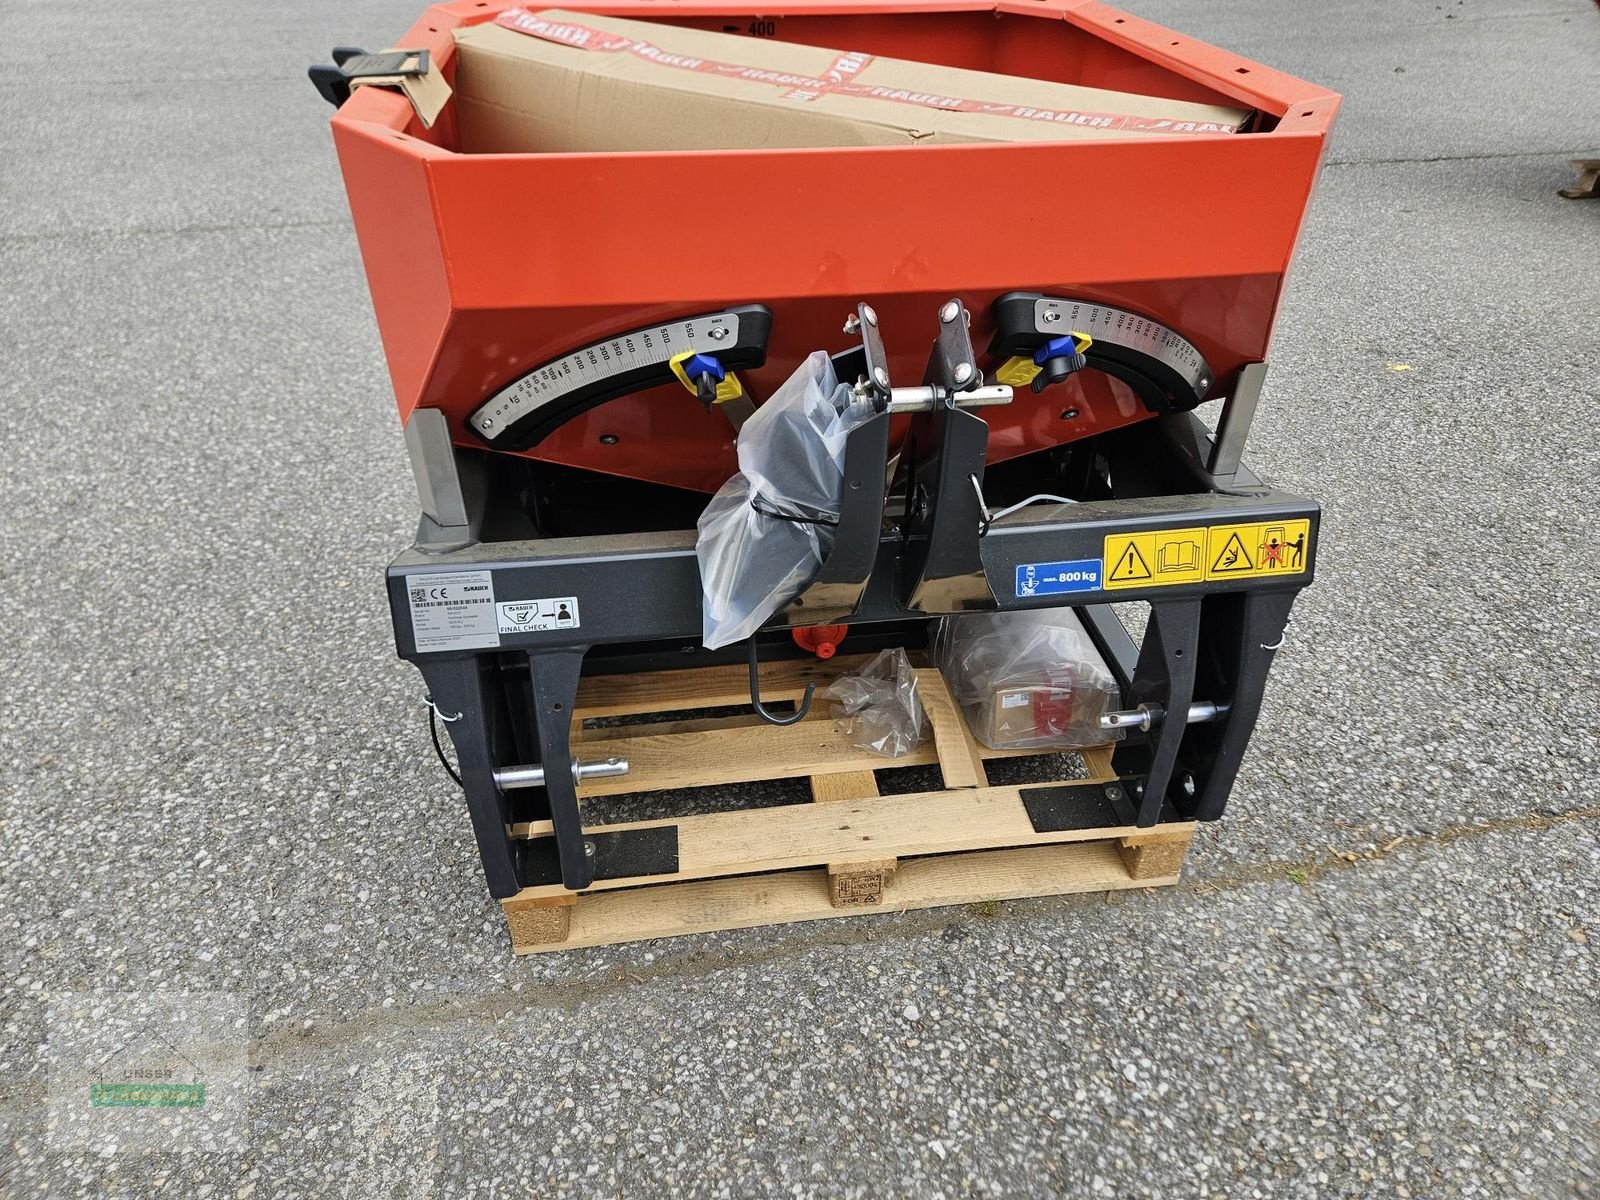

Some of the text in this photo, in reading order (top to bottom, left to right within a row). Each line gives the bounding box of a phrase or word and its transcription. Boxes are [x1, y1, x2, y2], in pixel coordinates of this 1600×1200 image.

[748, 21, 775, 36] 400
[870, 86, 962, 106] RAUCH
[1012, 107, 1114, 127] RAUCH
[1071, 305, 1079, 319] 550
[1090, 308, 1099, 323] 500
[1104, 311, 1112, 325] 450
[1117, 314, 1125, 328] 400
[1126, 317, 1134, 331] 350
[1135, 320, 1143, 334] 300
[660, 328, 671, 344] 500
[685, 323, 694, 338] 550
[1143, 323, 1151, 337] 250
[1152, 327, 1160, 341] 200
[625, 338, 636, 353] 400
[642, 333, 653, 348] 450
[600, 346, 610, 360] 300
[611, 341, 622, 356] 350
[574, 355, 584, 370] 200
[586, 350, 597, 364] 250
[547, 367, 557, 380] 100
[561, 361, 571, 374] 150
[1059, 572, 1081, 583] 800
[1081, 571, 1097, 582] kg
[500, 623, 548, 633] FINAL CHECK
